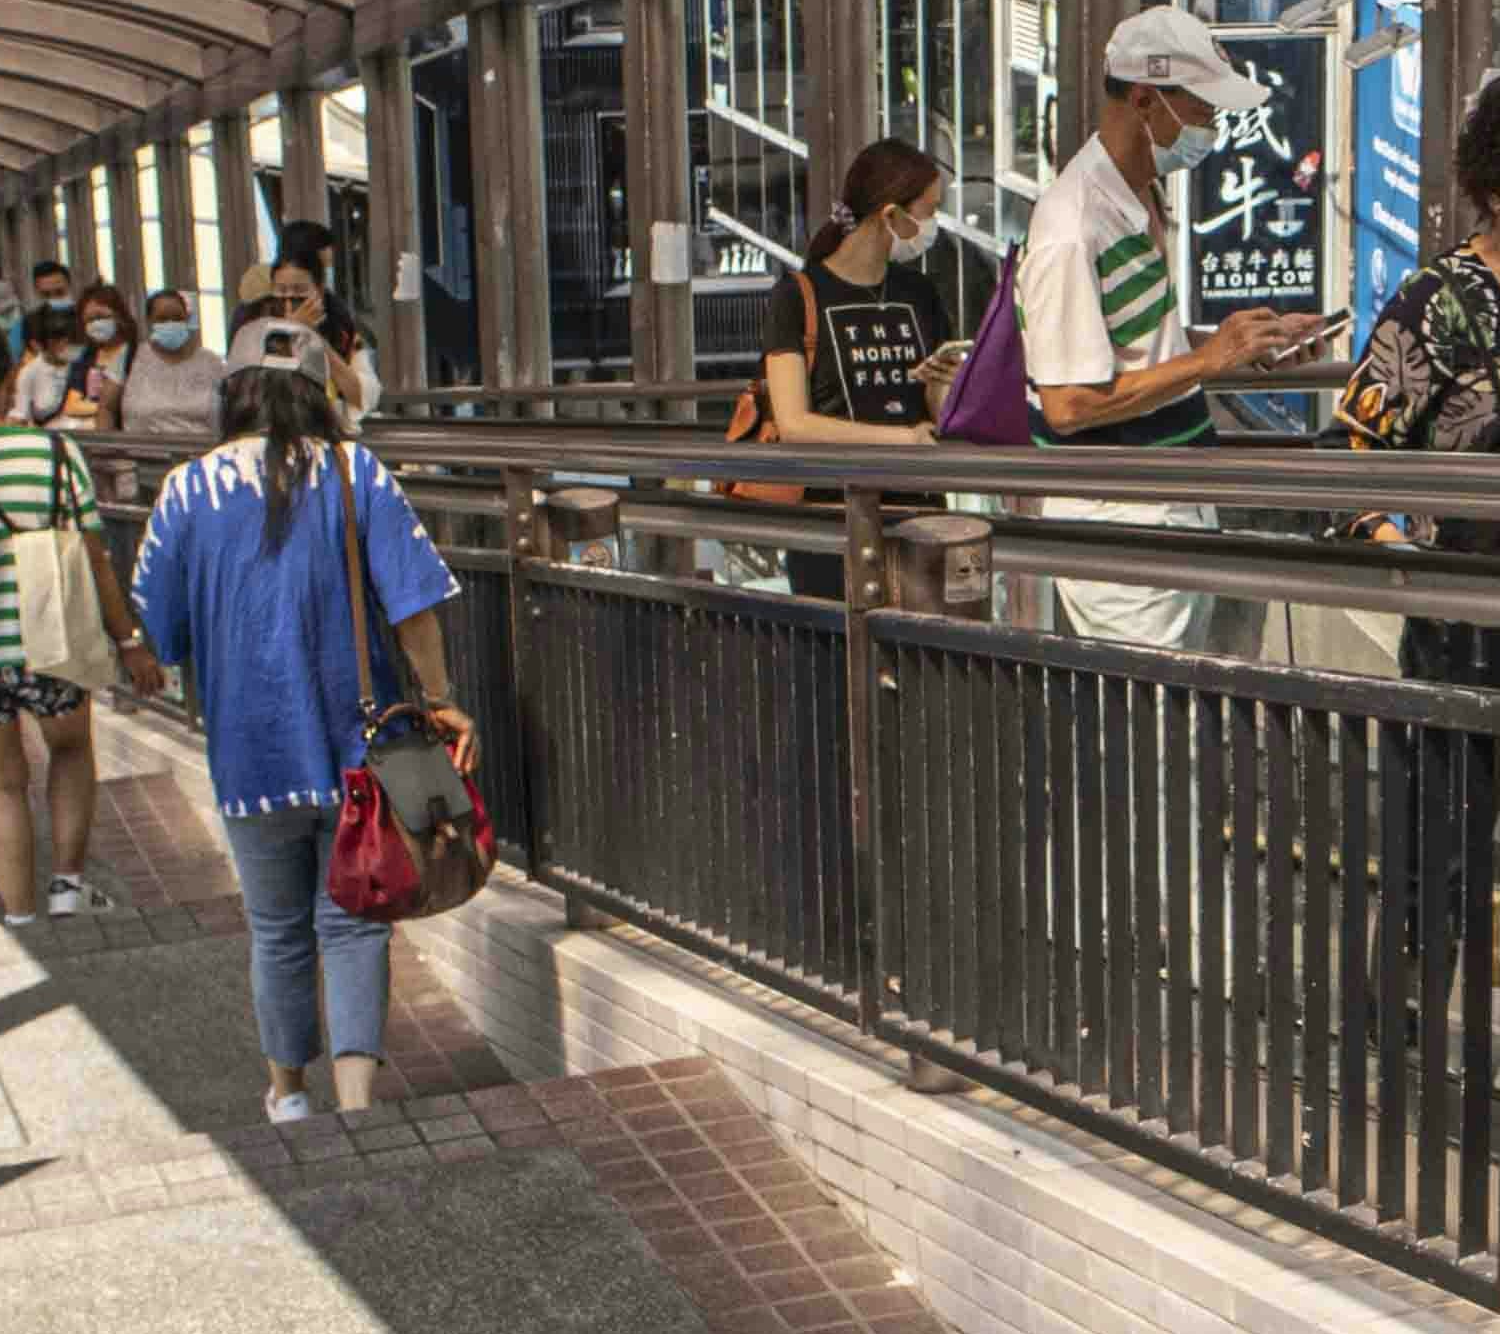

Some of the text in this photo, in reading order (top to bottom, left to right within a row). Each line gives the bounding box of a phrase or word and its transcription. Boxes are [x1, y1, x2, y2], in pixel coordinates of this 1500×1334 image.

[1202, 270, 1315, 287] IRON COW
[844, 323, 912, 340] THE
[851, 346, 916, 362] NORTH
